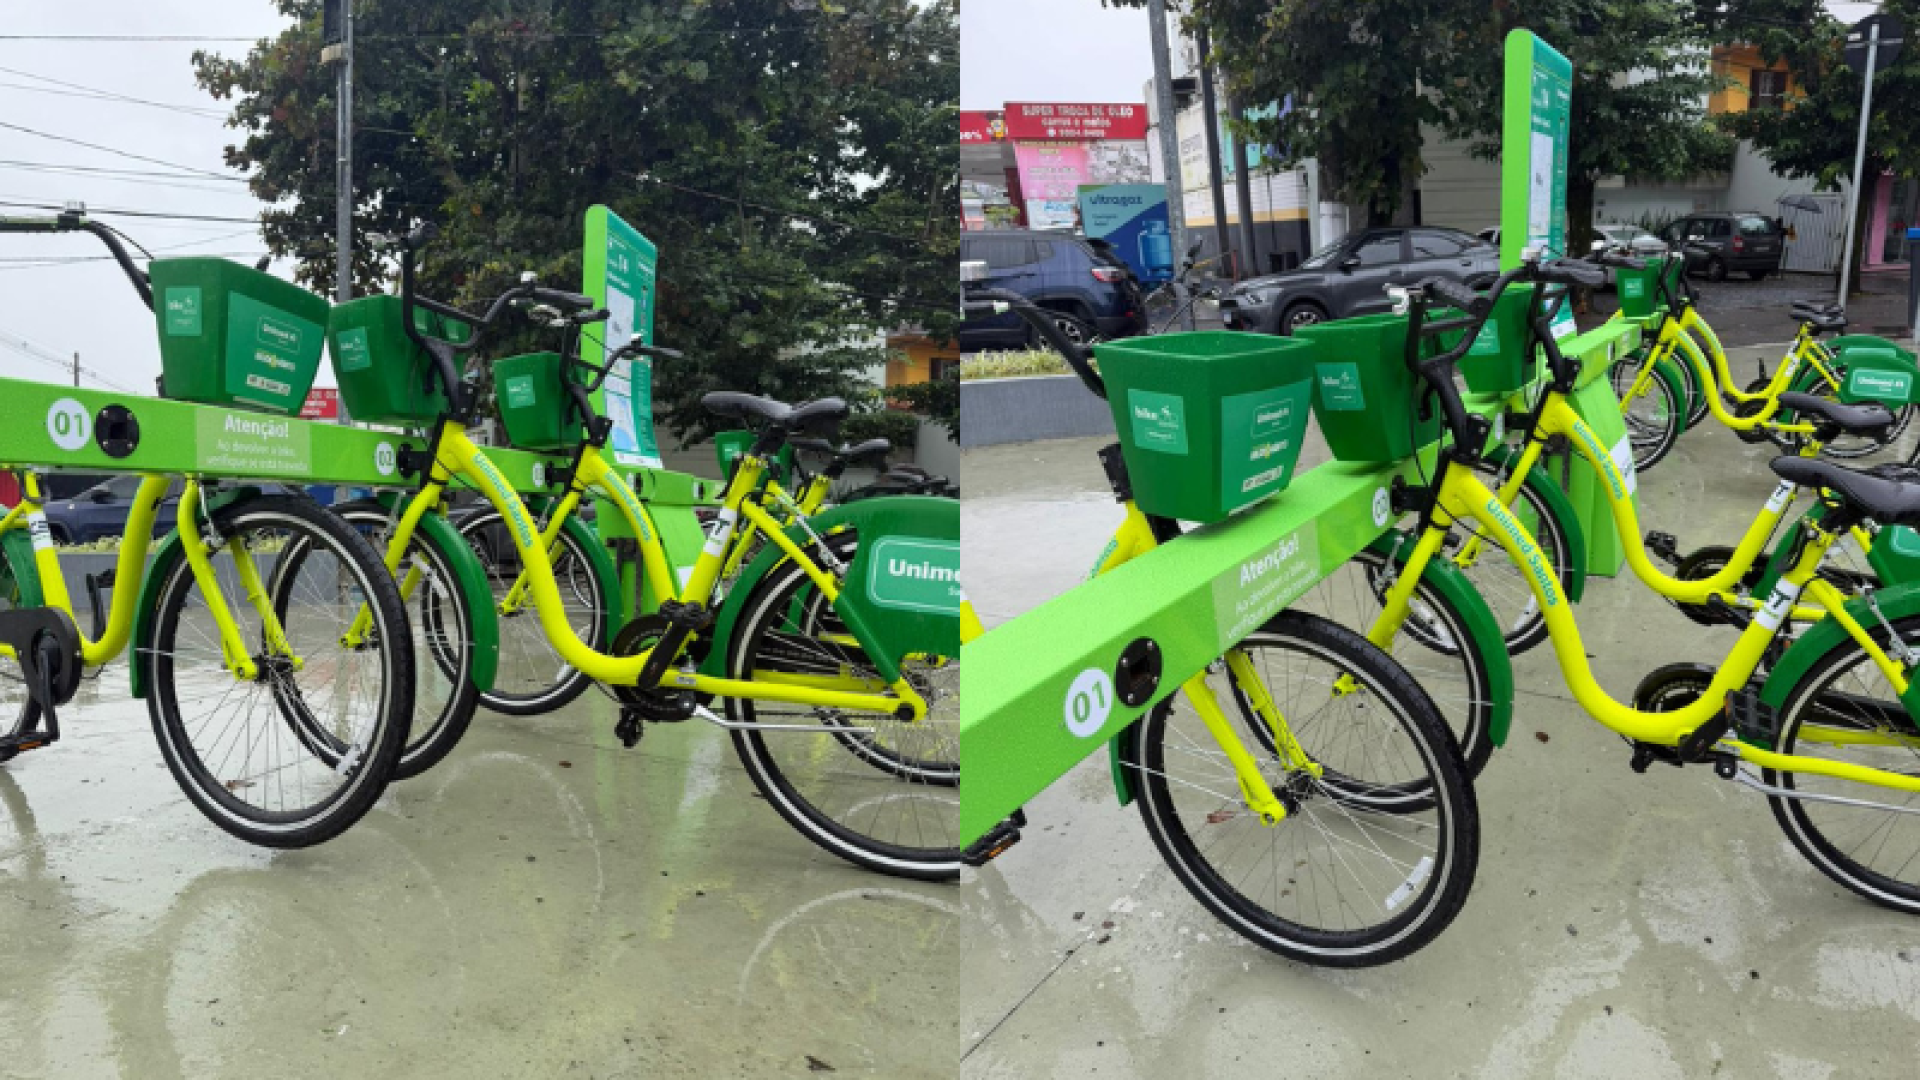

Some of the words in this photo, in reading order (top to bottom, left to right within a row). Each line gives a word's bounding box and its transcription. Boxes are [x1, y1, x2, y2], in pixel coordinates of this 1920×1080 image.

[1022, 105, 1054, 116] SUPER
[1057, 105, 1089, 116] TROCA
[1091, 105, 1104, 116] DE
[1089, 194, 1143, 207] ultragaz
[54, 411, 85, 438] 01
[224, 413, 289, 441] Atenção!
[377, 450, 394, 467] 02
[1240, 532, 1299, 588] Atenção!
[1486, 498, 1534, 555] Unimed
[1528, 553, 1558, 606] Santos
[1072, 680, 1106, 724] 01
